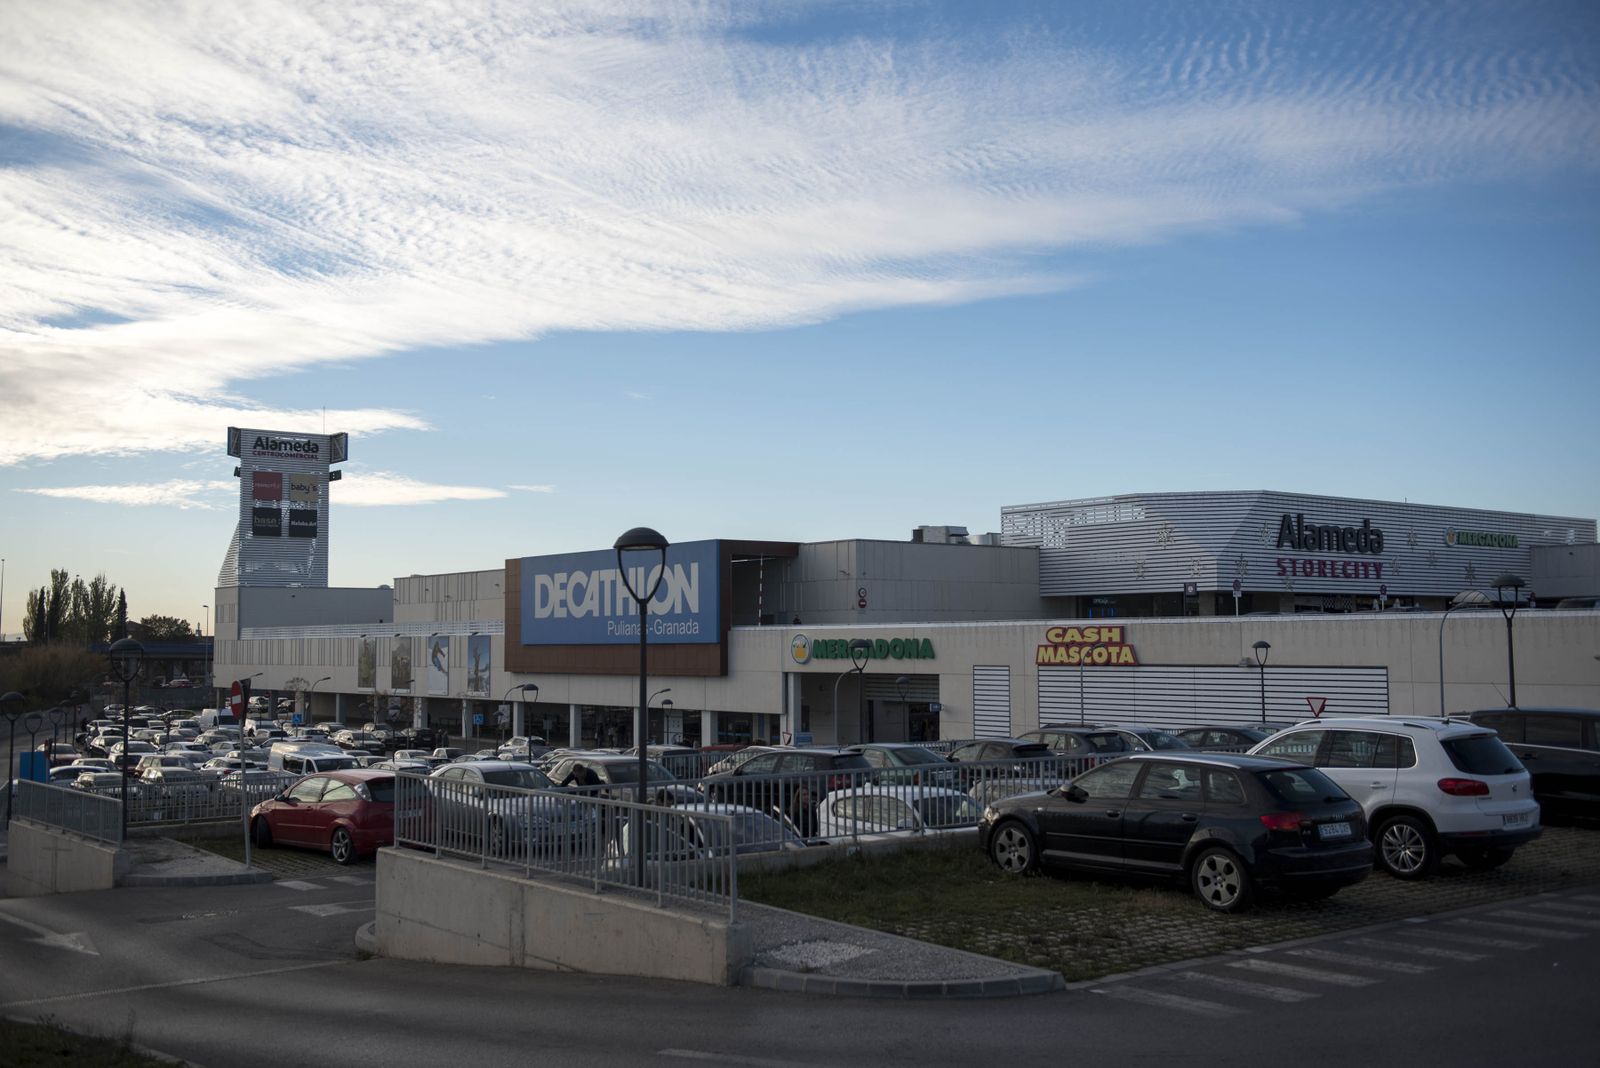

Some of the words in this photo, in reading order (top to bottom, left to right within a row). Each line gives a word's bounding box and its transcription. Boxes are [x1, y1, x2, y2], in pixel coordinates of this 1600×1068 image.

[253, 436, 319, 453] Alameda
[1277, 513, 1384, 554] Alameda
[1458, 531, 1519, 548] MERCADONA
[534, 562, 700, 619] DECATHLON
[1047, 627, 1121, 643] CASH
[1037, 645, 1135, 664] MASCOTA
